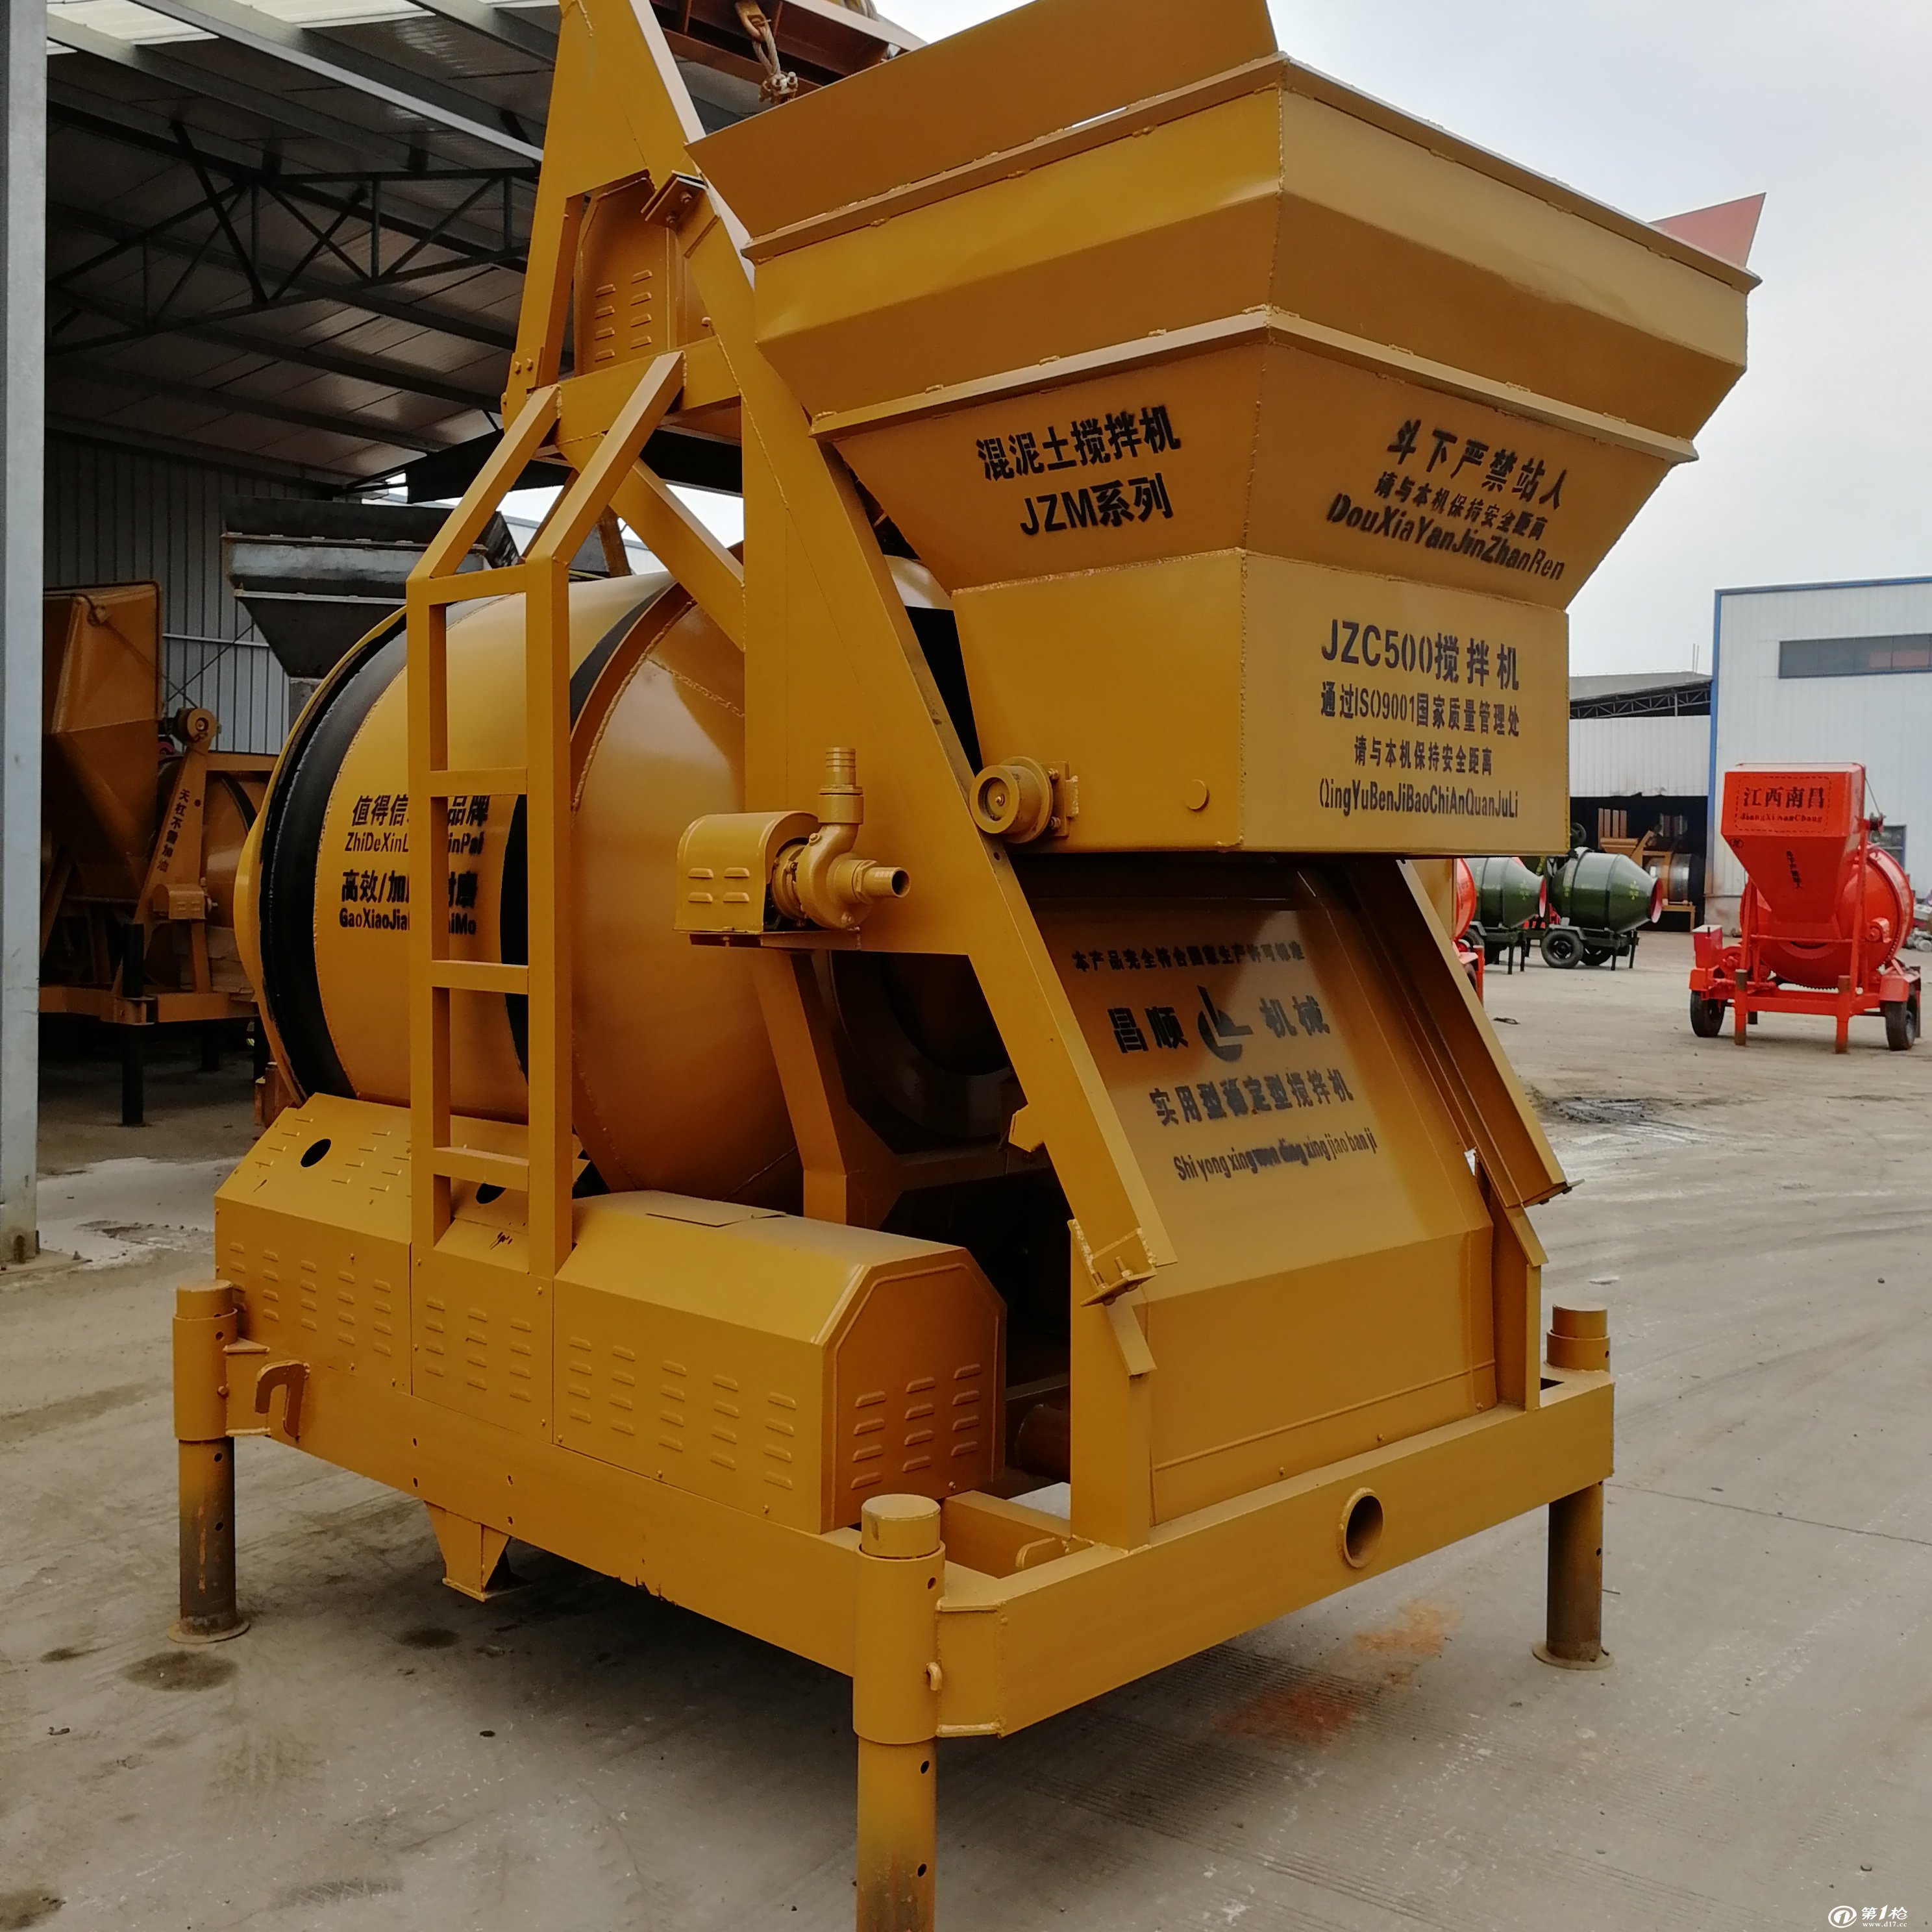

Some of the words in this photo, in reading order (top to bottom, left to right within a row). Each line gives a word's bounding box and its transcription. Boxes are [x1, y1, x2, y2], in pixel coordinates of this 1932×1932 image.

[976, 405, 1182, 481] 混泥土搅拌机
[1387, 419, 1568, 510] 斗下严禁站人
[1020, 473, 1174, 536] JZM系列
[1374, 471, 1549, 541] 请与本机保持安全距离
[1326, 493, 1565, 580] DouXiaYanJinZhanRen
[1321, 619, 1519, 691] JZC500搅拌机
[1354, 735, 1492, 776] 请与本机保持安全距离
[1319, 778, 1518, 818] QingYuBenJiBaoChiAnQuanJuLi
[1743, 786, 1825, 809] 江西南昌
[1259, 995, 1330, 1038] 机械
[1173, 1154, 1198, 1181] Shi
[1196, 1156, 1232, 1182] yong
[1227, 1146, 1258, 1174] xing
[1304, 1135, 1331, 1161] xing
[1344, 1130, 1369, 1152] ban
[1364, 1127, 1378, 1154] ji
